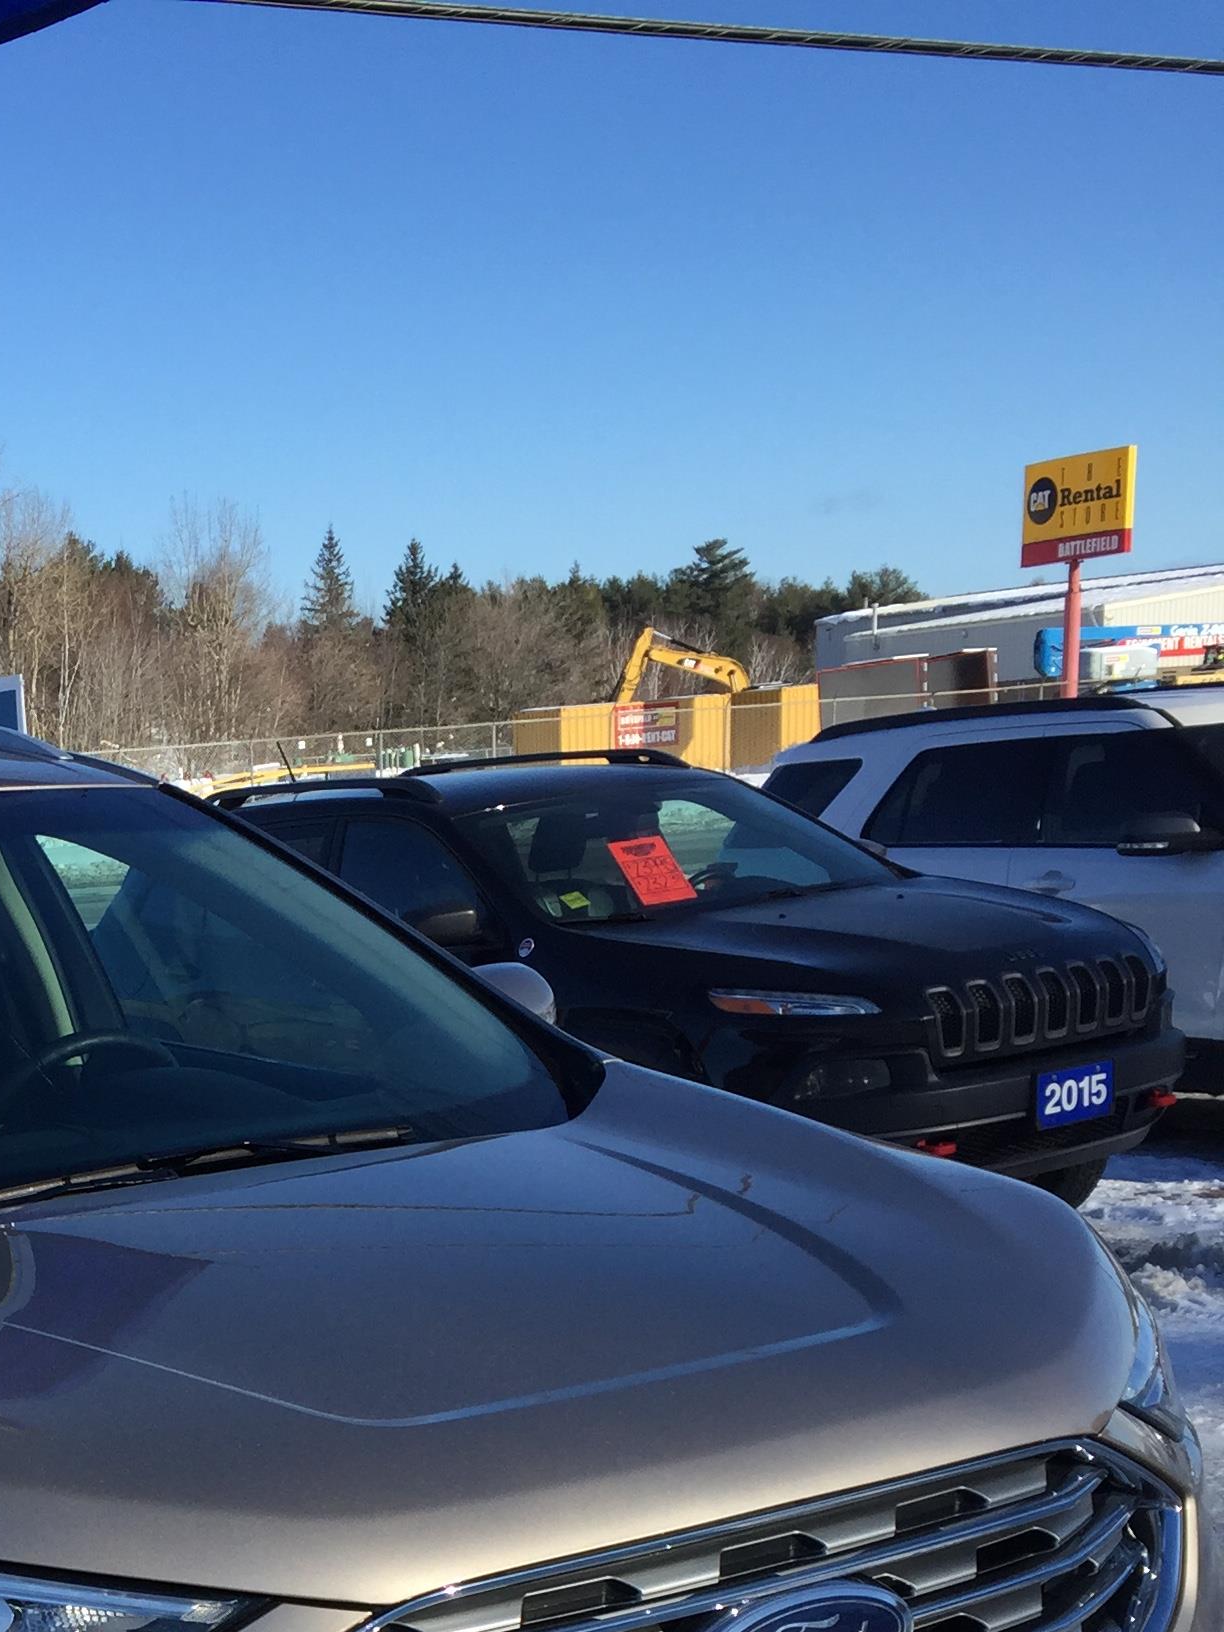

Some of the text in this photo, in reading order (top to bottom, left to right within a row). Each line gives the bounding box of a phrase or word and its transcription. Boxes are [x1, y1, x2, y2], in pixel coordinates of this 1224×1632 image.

[1030, 490, 1051, 513] CAT
[1059, 479, 1122, 507] Rental
[1059, 500, 1120, 529] STORE
[1058, 535, 1119, 558] BATTLEFIELD
[1044, 1073, 1108, 1116] 2015
